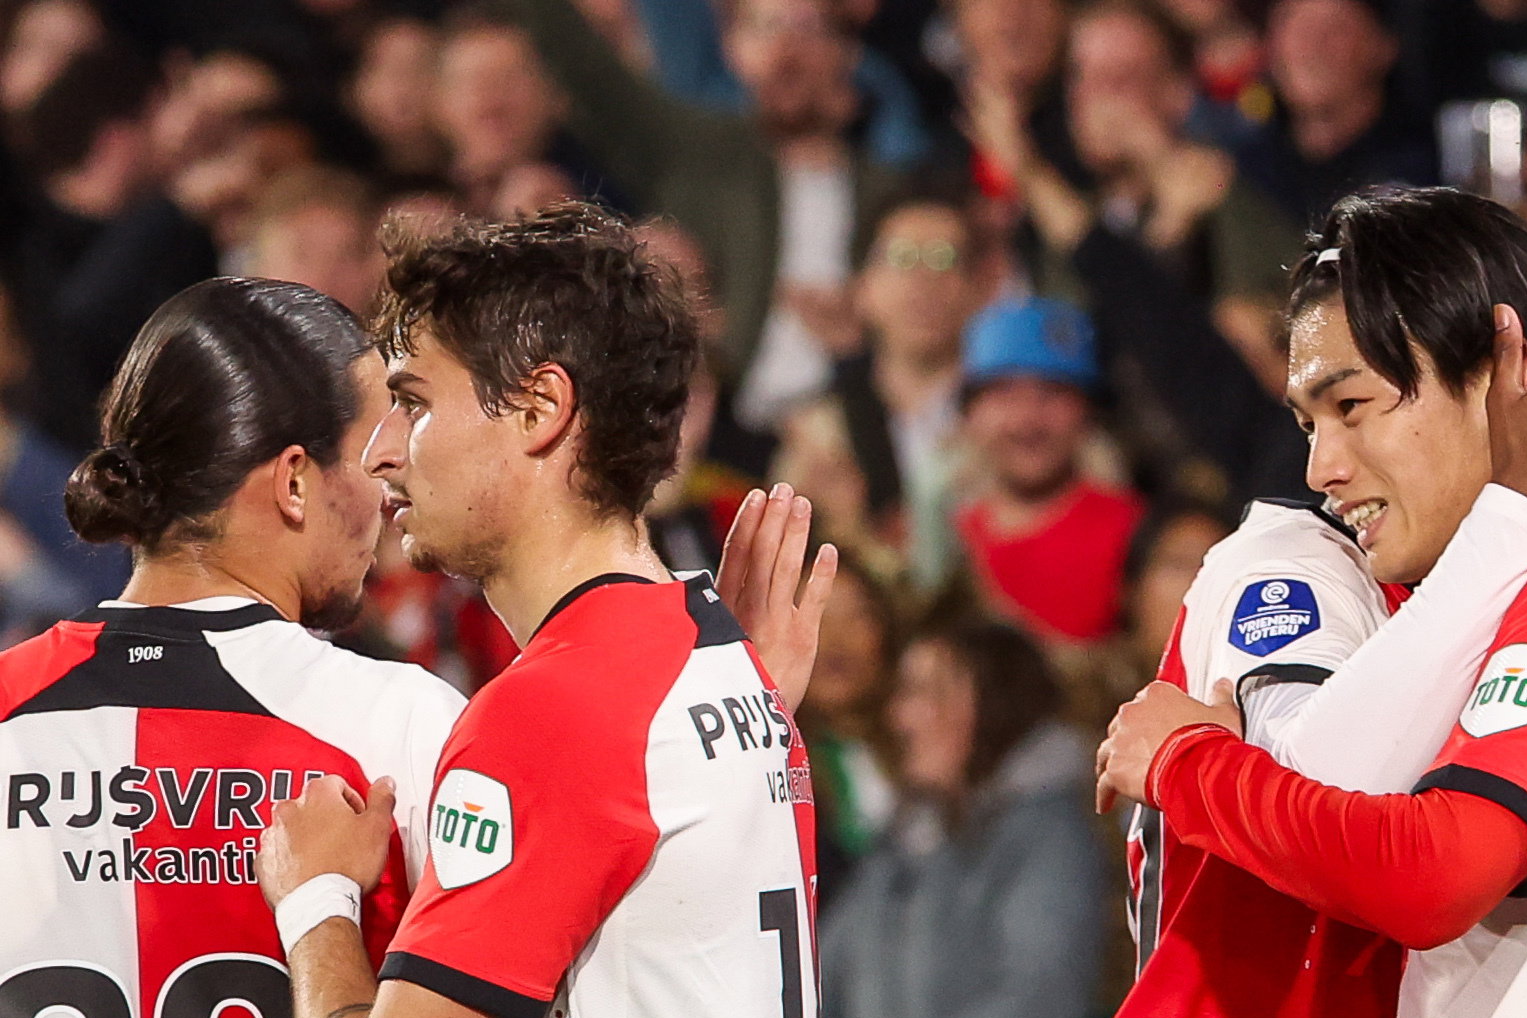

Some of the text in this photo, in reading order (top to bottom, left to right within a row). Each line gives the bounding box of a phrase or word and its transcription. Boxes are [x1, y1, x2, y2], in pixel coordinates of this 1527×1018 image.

[1237, 614, 1311, 634] VRIENDEN
[128, 646, 163, 663] 1908
[436, 804, 499, 854] TOTO
[62, 837, 258, 884] vakanti
